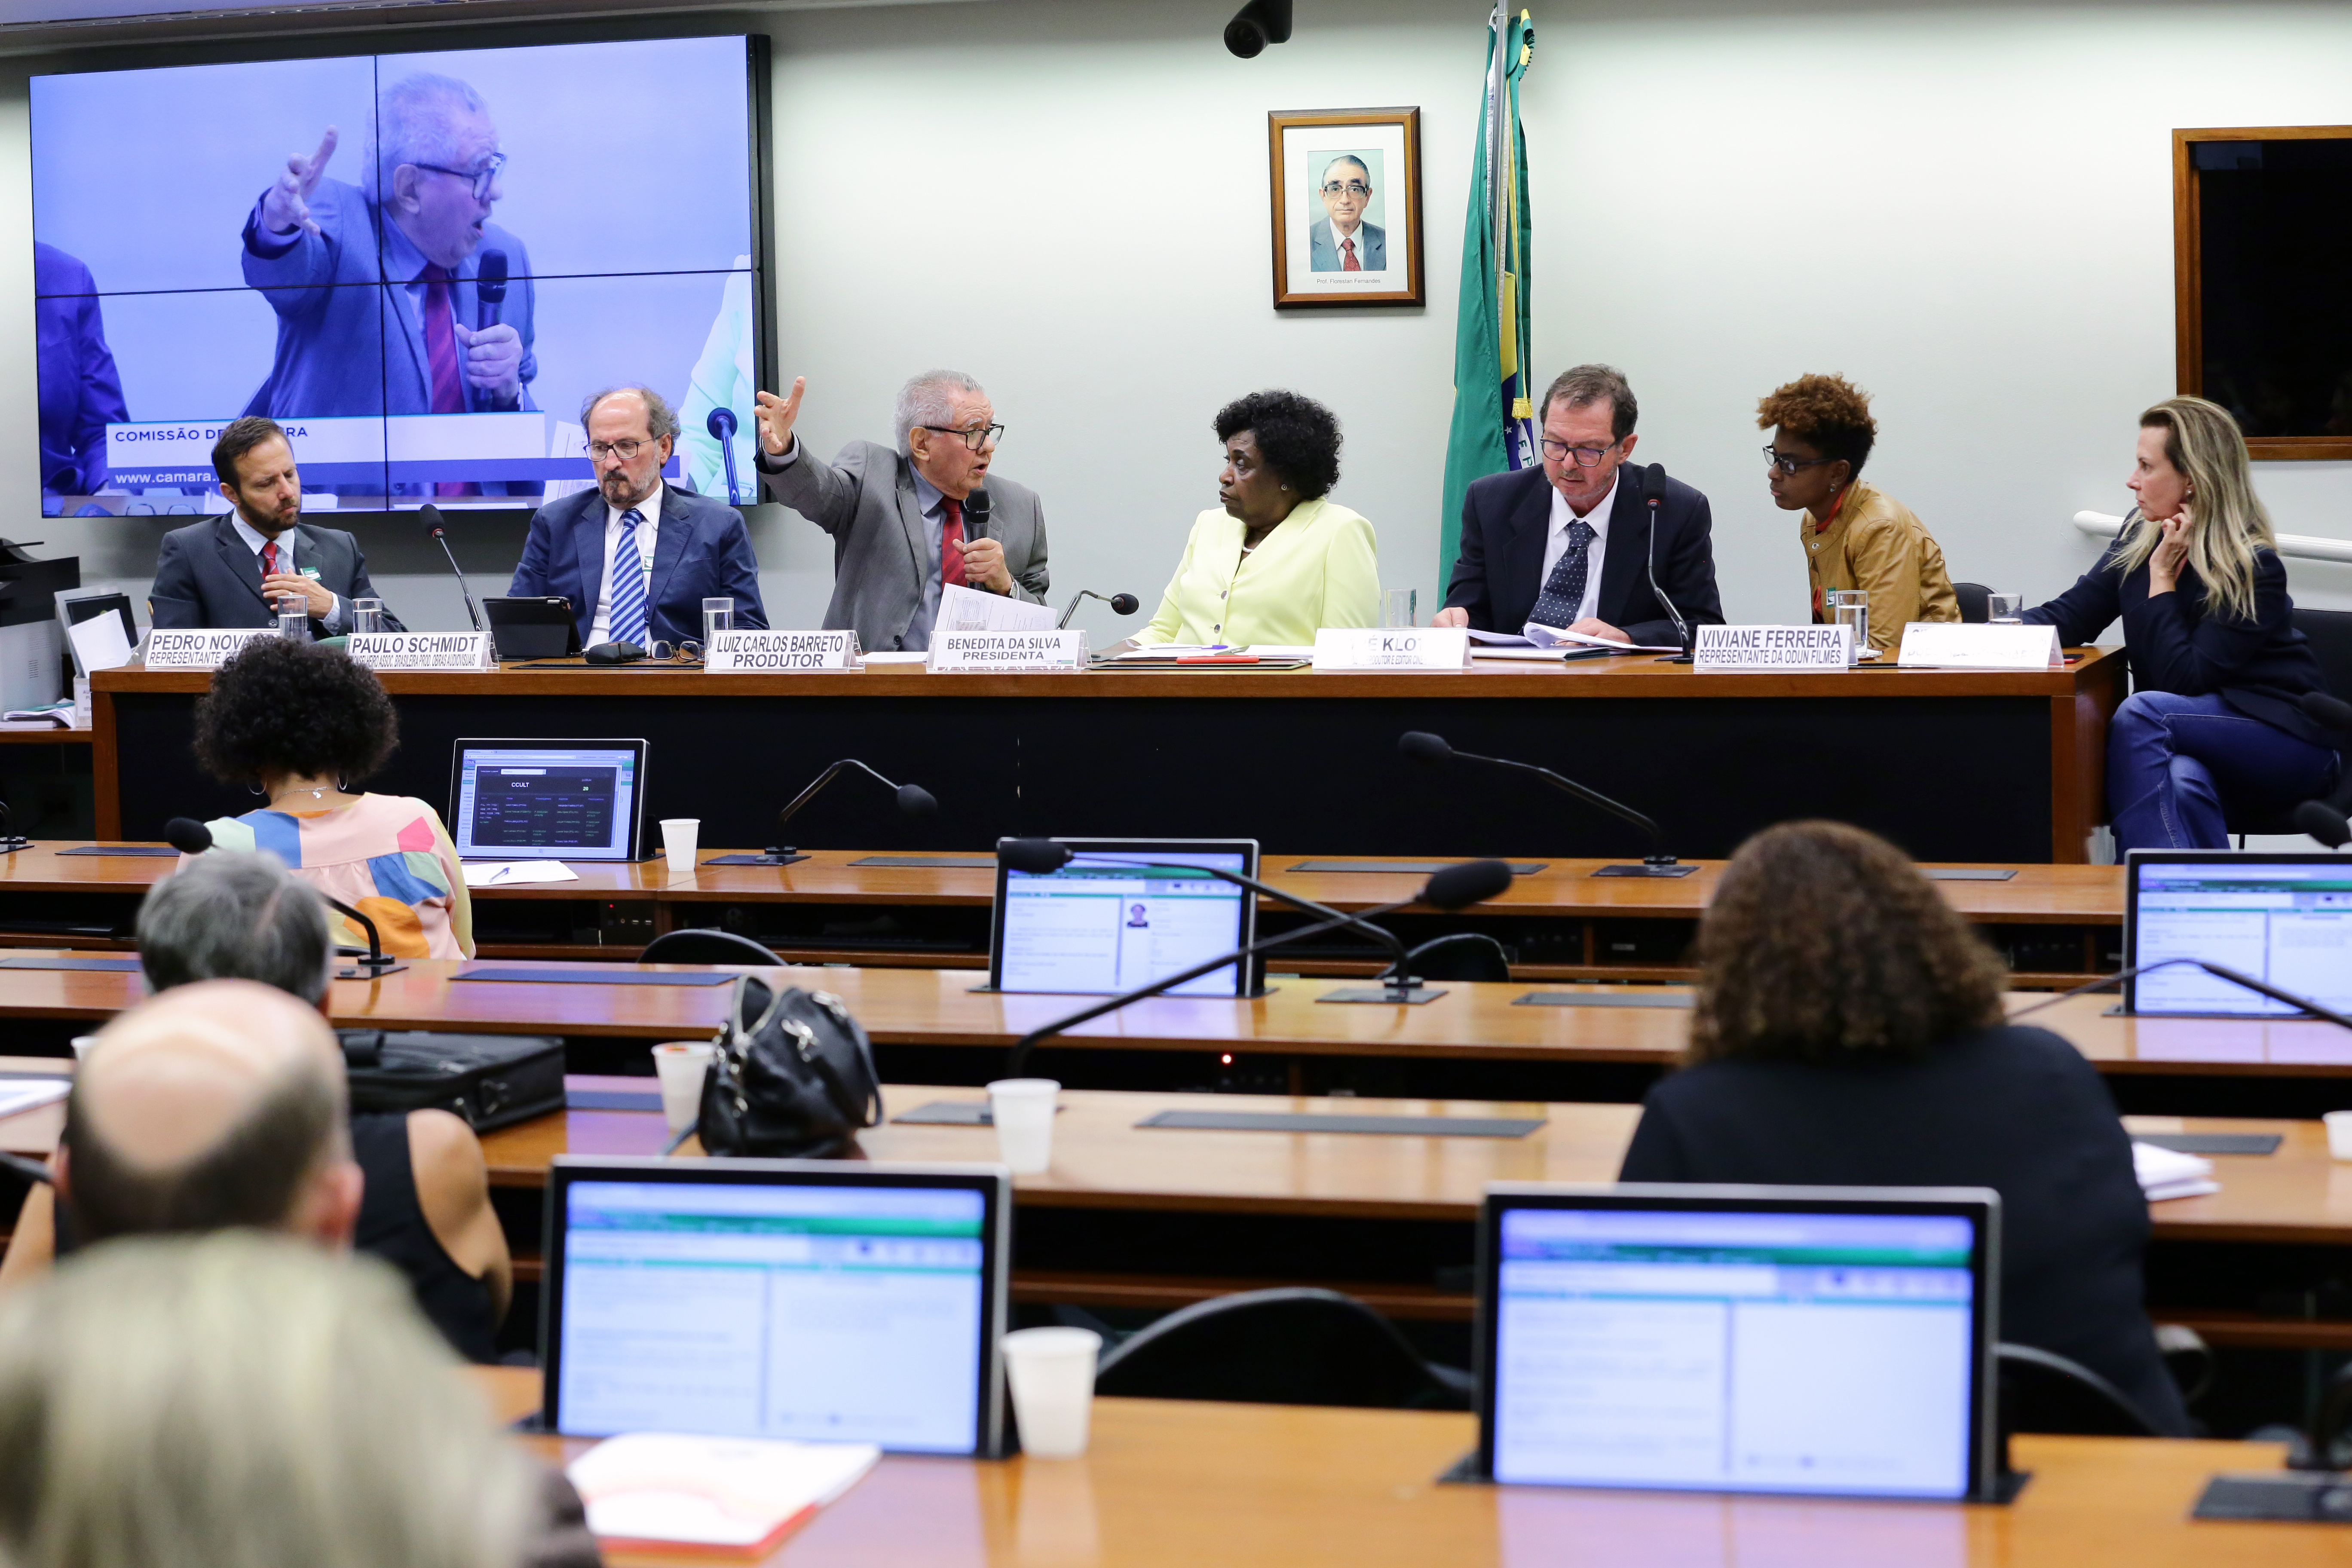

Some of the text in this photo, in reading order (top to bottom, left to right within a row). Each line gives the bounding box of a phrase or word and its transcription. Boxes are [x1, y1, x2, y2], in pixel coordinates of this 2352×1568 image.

[116, 428, 199, 442] COMISSÃO
[115, 472, 219, 484] www.camara.
[152, 635, 205, 650] PEDRO
[352, 637, 478, 654] PAULO SCHMIDT
[717, 635, 843, 652] LUIZ CARLOS BARRETO
[947, 637, 1061, 650] BENEDITA DA SILVA
[1702, 630, 1841, 648] VIVIANE FERREIRA
[149, 652, 221, 664] REPRESENTANTE
[378, 655, 394, 667] ASSOC.
[394, 654, 419, 668] BRASILEIRA
[419, 654, 431, 667] PROD.
[432, 654, 447, 667] OBRAS
[446, 653, 475, 667] AUDIOVISUAIS
[733, 654, 824, 668] PRODUTOR
[963, 651, 1044, 660] PRESIDENTA
[1698, 649, 1841, 664] REPRESENTANTE DA ODUN FILMES
